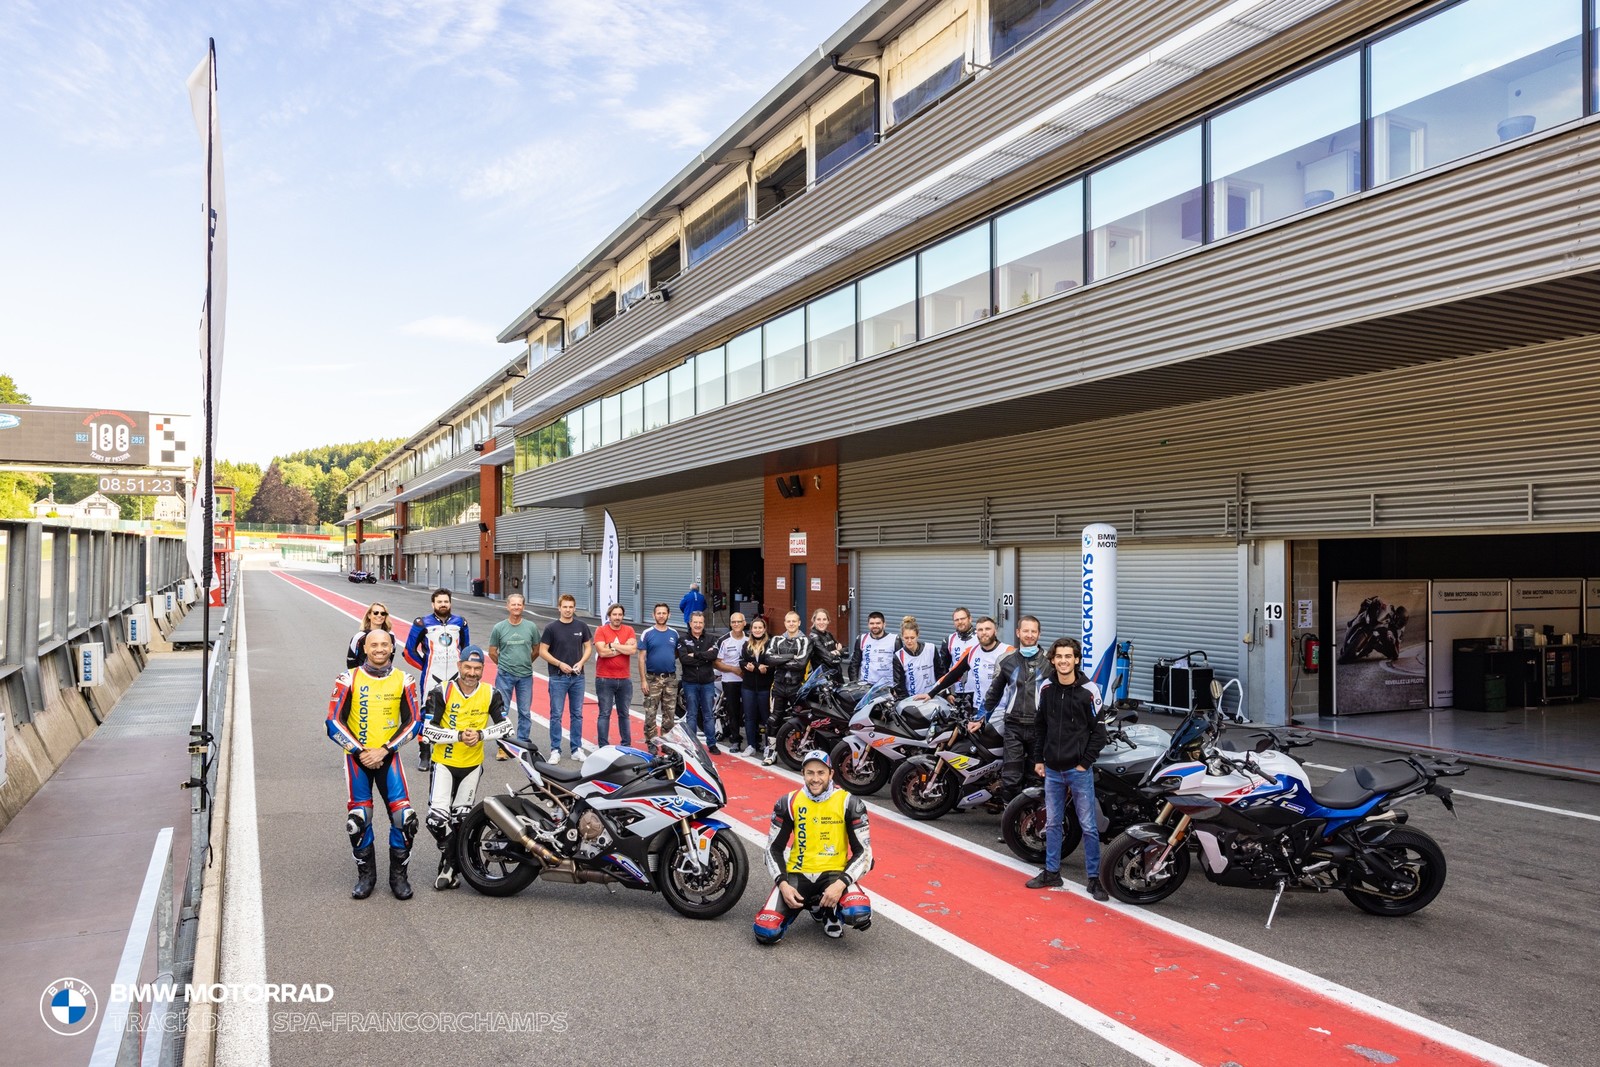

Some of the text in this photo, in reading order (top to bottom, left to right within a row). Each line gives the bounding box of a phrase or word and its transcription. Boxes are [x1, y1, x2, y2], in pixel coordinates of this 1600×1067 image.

[90, 423, 129, 452] 100
[100, 478, 172, 492] 08:51:23
[849, 588, 856, 597] 21
[1003, 594, 1014, 606] 20
[1083, 553, 1094, 671] TRACKDAYS
[1265, 604, 1282, 619] 19
[359, 685, 370, 745] RACKDAYS
